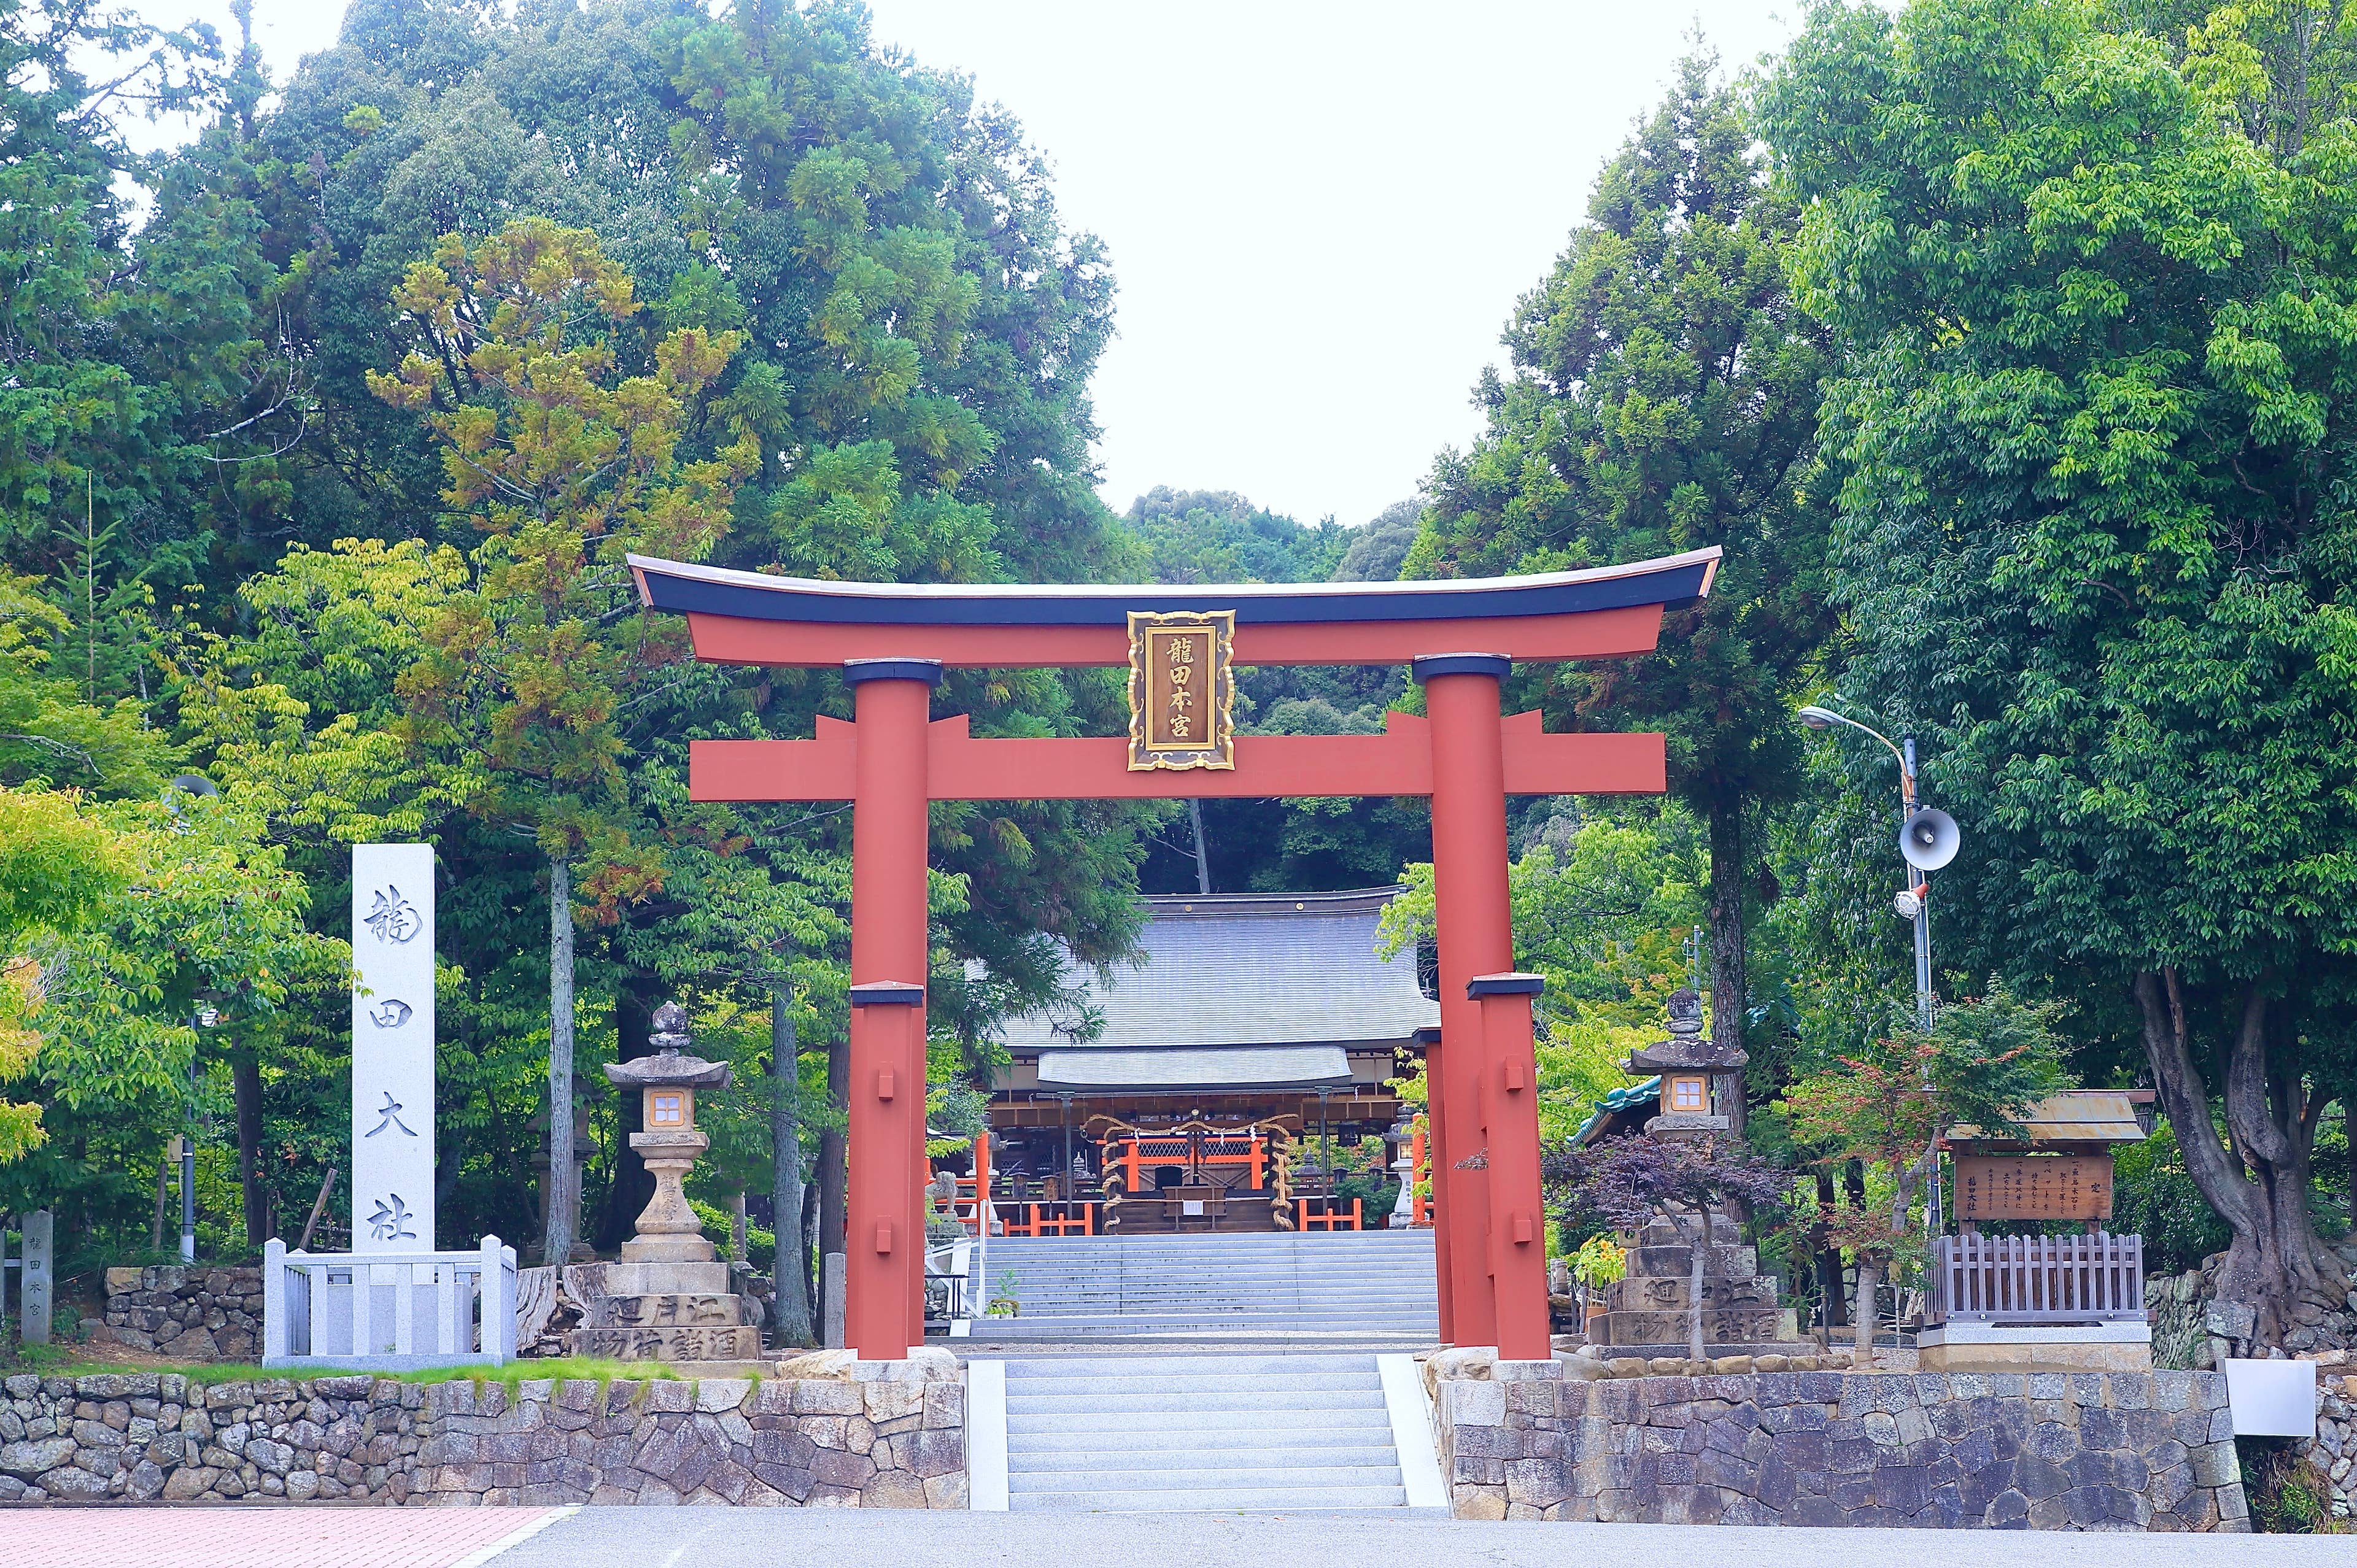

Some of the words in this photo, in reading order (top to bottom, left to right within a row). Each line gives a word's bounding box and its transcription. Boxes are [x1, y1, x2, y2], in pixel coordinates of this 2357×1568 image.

[1166, 637, 1194, 738] 龍田本宮
[363, 884, 423, 1242] 龍田大社
[1967, 1175, 1977, 1211] 龍田大社
[2091, 1183, 2100, 1193] 定
[29, 1237, 42, 1316] 龍田本宮
